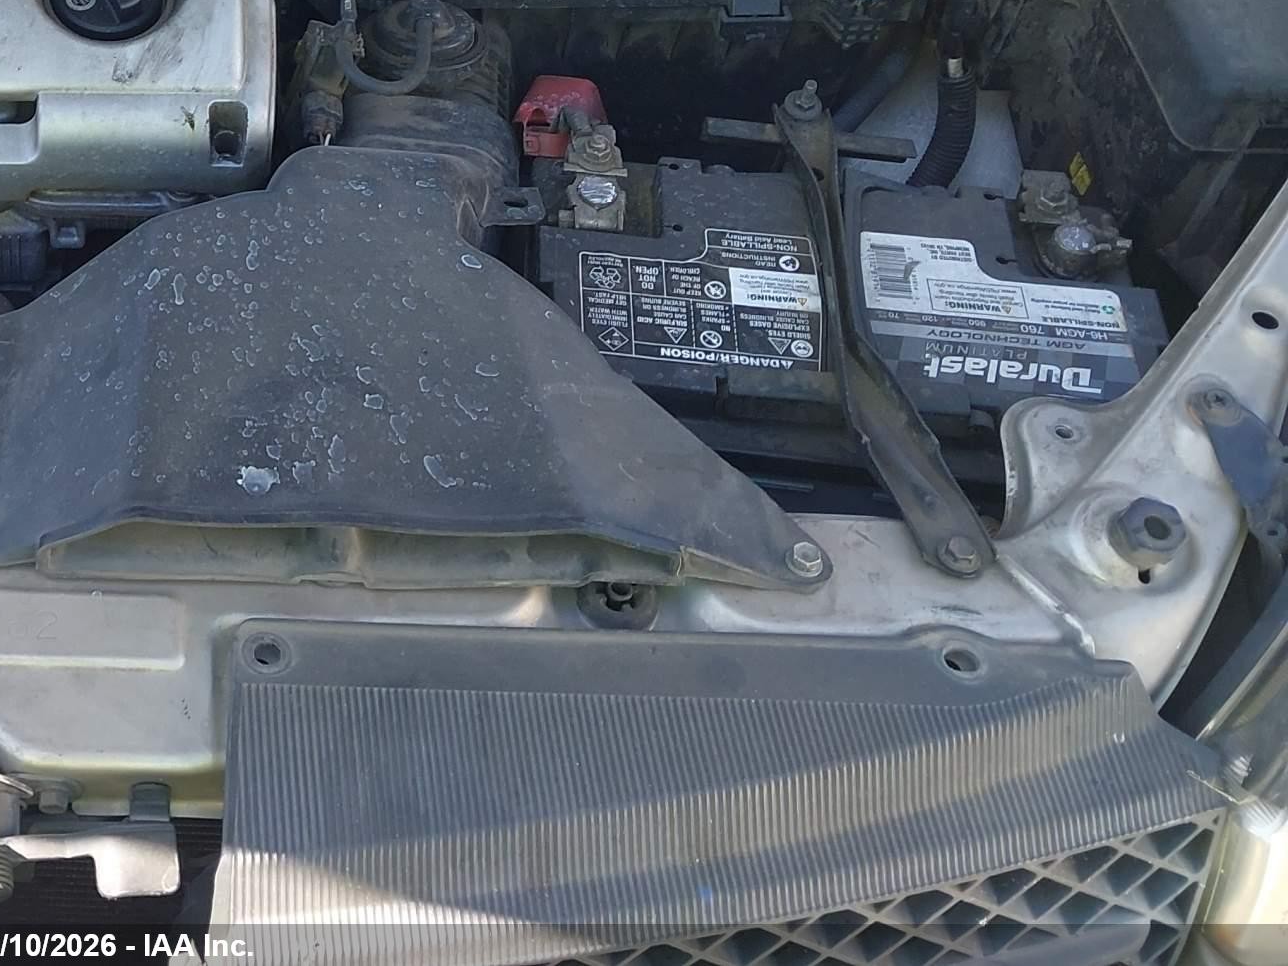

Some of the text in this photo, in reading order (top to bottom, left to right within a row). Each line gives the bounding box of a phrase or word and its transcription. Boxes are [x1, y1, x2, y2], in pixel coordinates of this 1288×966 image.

[721, 239, 797, 252] NON-SPILLABLE
[632, 265, 659, 275] OPEN.
[638, 274, 656, 282] NOT
[641, 282, 654, 290] DO
[747, 294, 798, 304] WARNING:
[945, 301, 1001, 313] WARNING:
[637, 316, 687, 327] SULFURIC ACID
[1041, 316, 1120, 328] NON-SPILLABLE
[1020, 324, 1045, 335] 760
[1055, 327, 1108, 341] H6-AGM
[927, 328, 1085, 350] AGM TECHNOLOGY
[925, 340, 1028, 360] PLATINUM
[660, 347, 780, 368] DANGER/POISON
[923, 353, 1102, 395] Duralast
